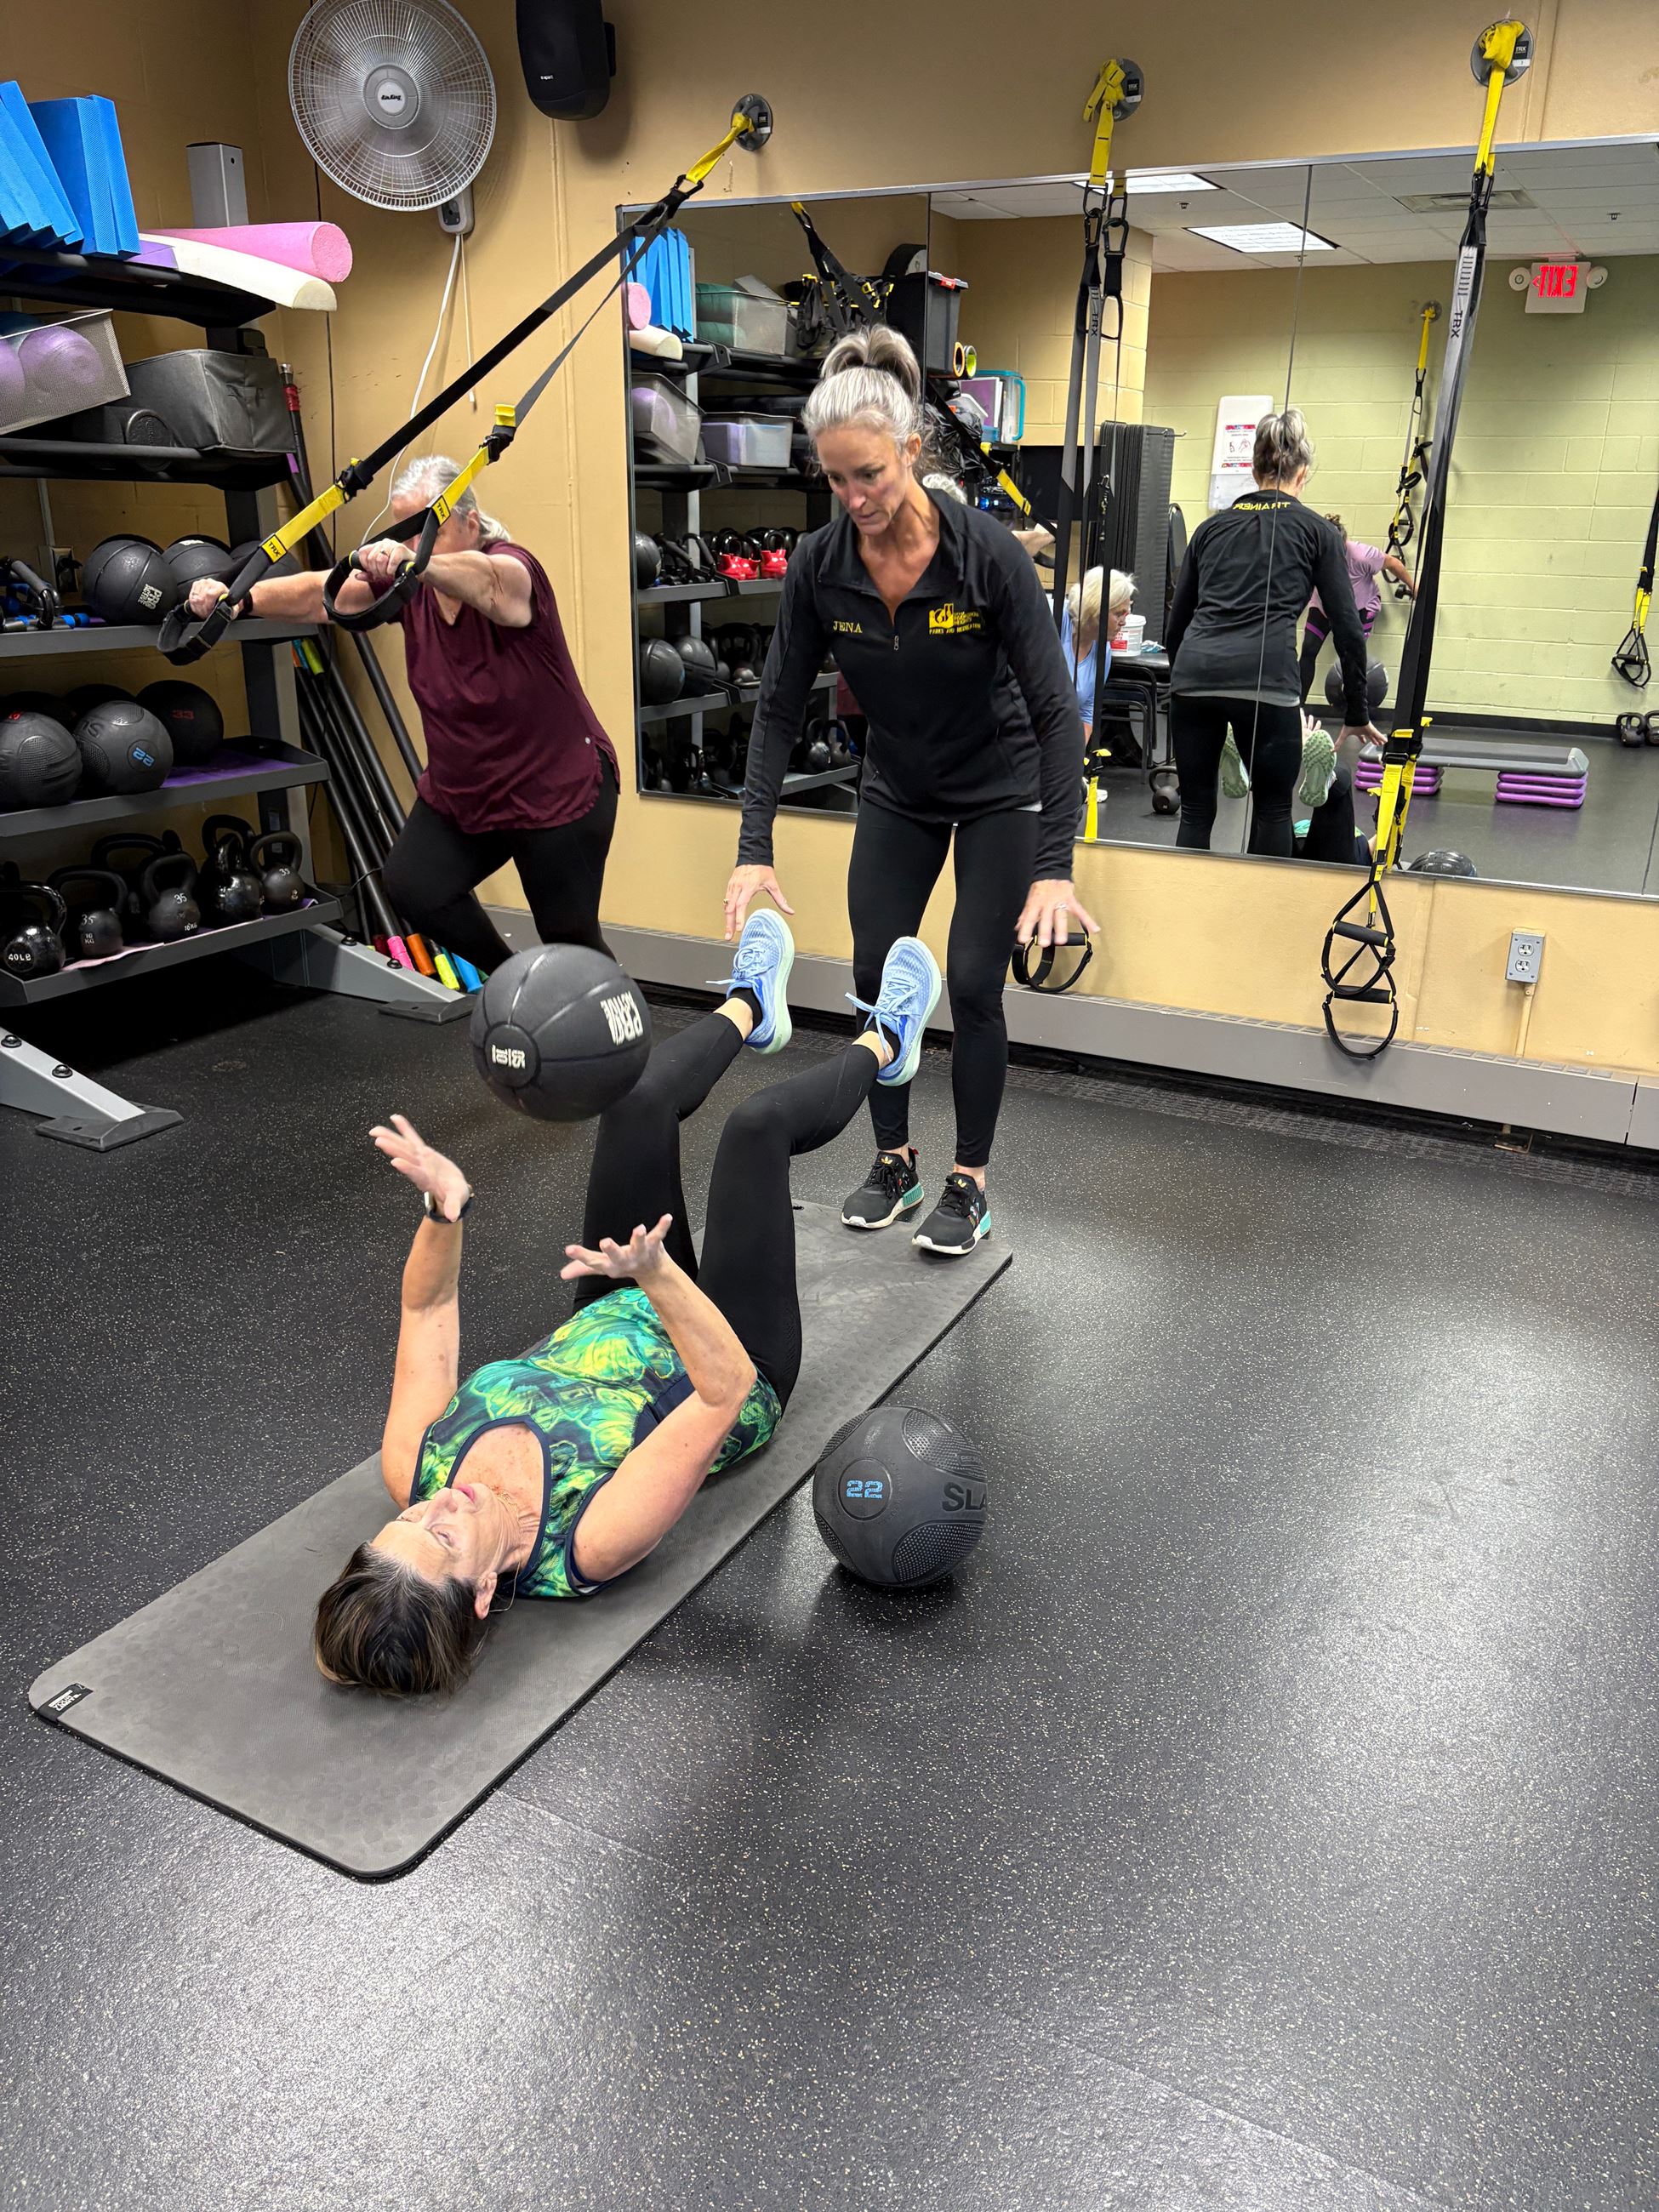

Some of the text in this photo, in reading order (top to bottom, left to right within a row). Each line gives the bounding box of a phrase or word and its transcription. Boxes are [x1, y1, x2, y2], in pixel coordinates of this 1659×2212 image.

[1091, 312, 1099, 337] TRX
[1450, 310, 1463, 339] TRX
[436, 502, 448, 520] TRX
[268, 540, 282, 557] TRX
[832, 620, 864, 634] JENA
[171, 709, 195, 721] 33
[132, 746, 156, 768] 22
[279, 868, 291, 877] 35
[174, 892, 188, 904] 35
[81, 913, 97, 926] 35
[845, 1479, 884, 1499] 22
